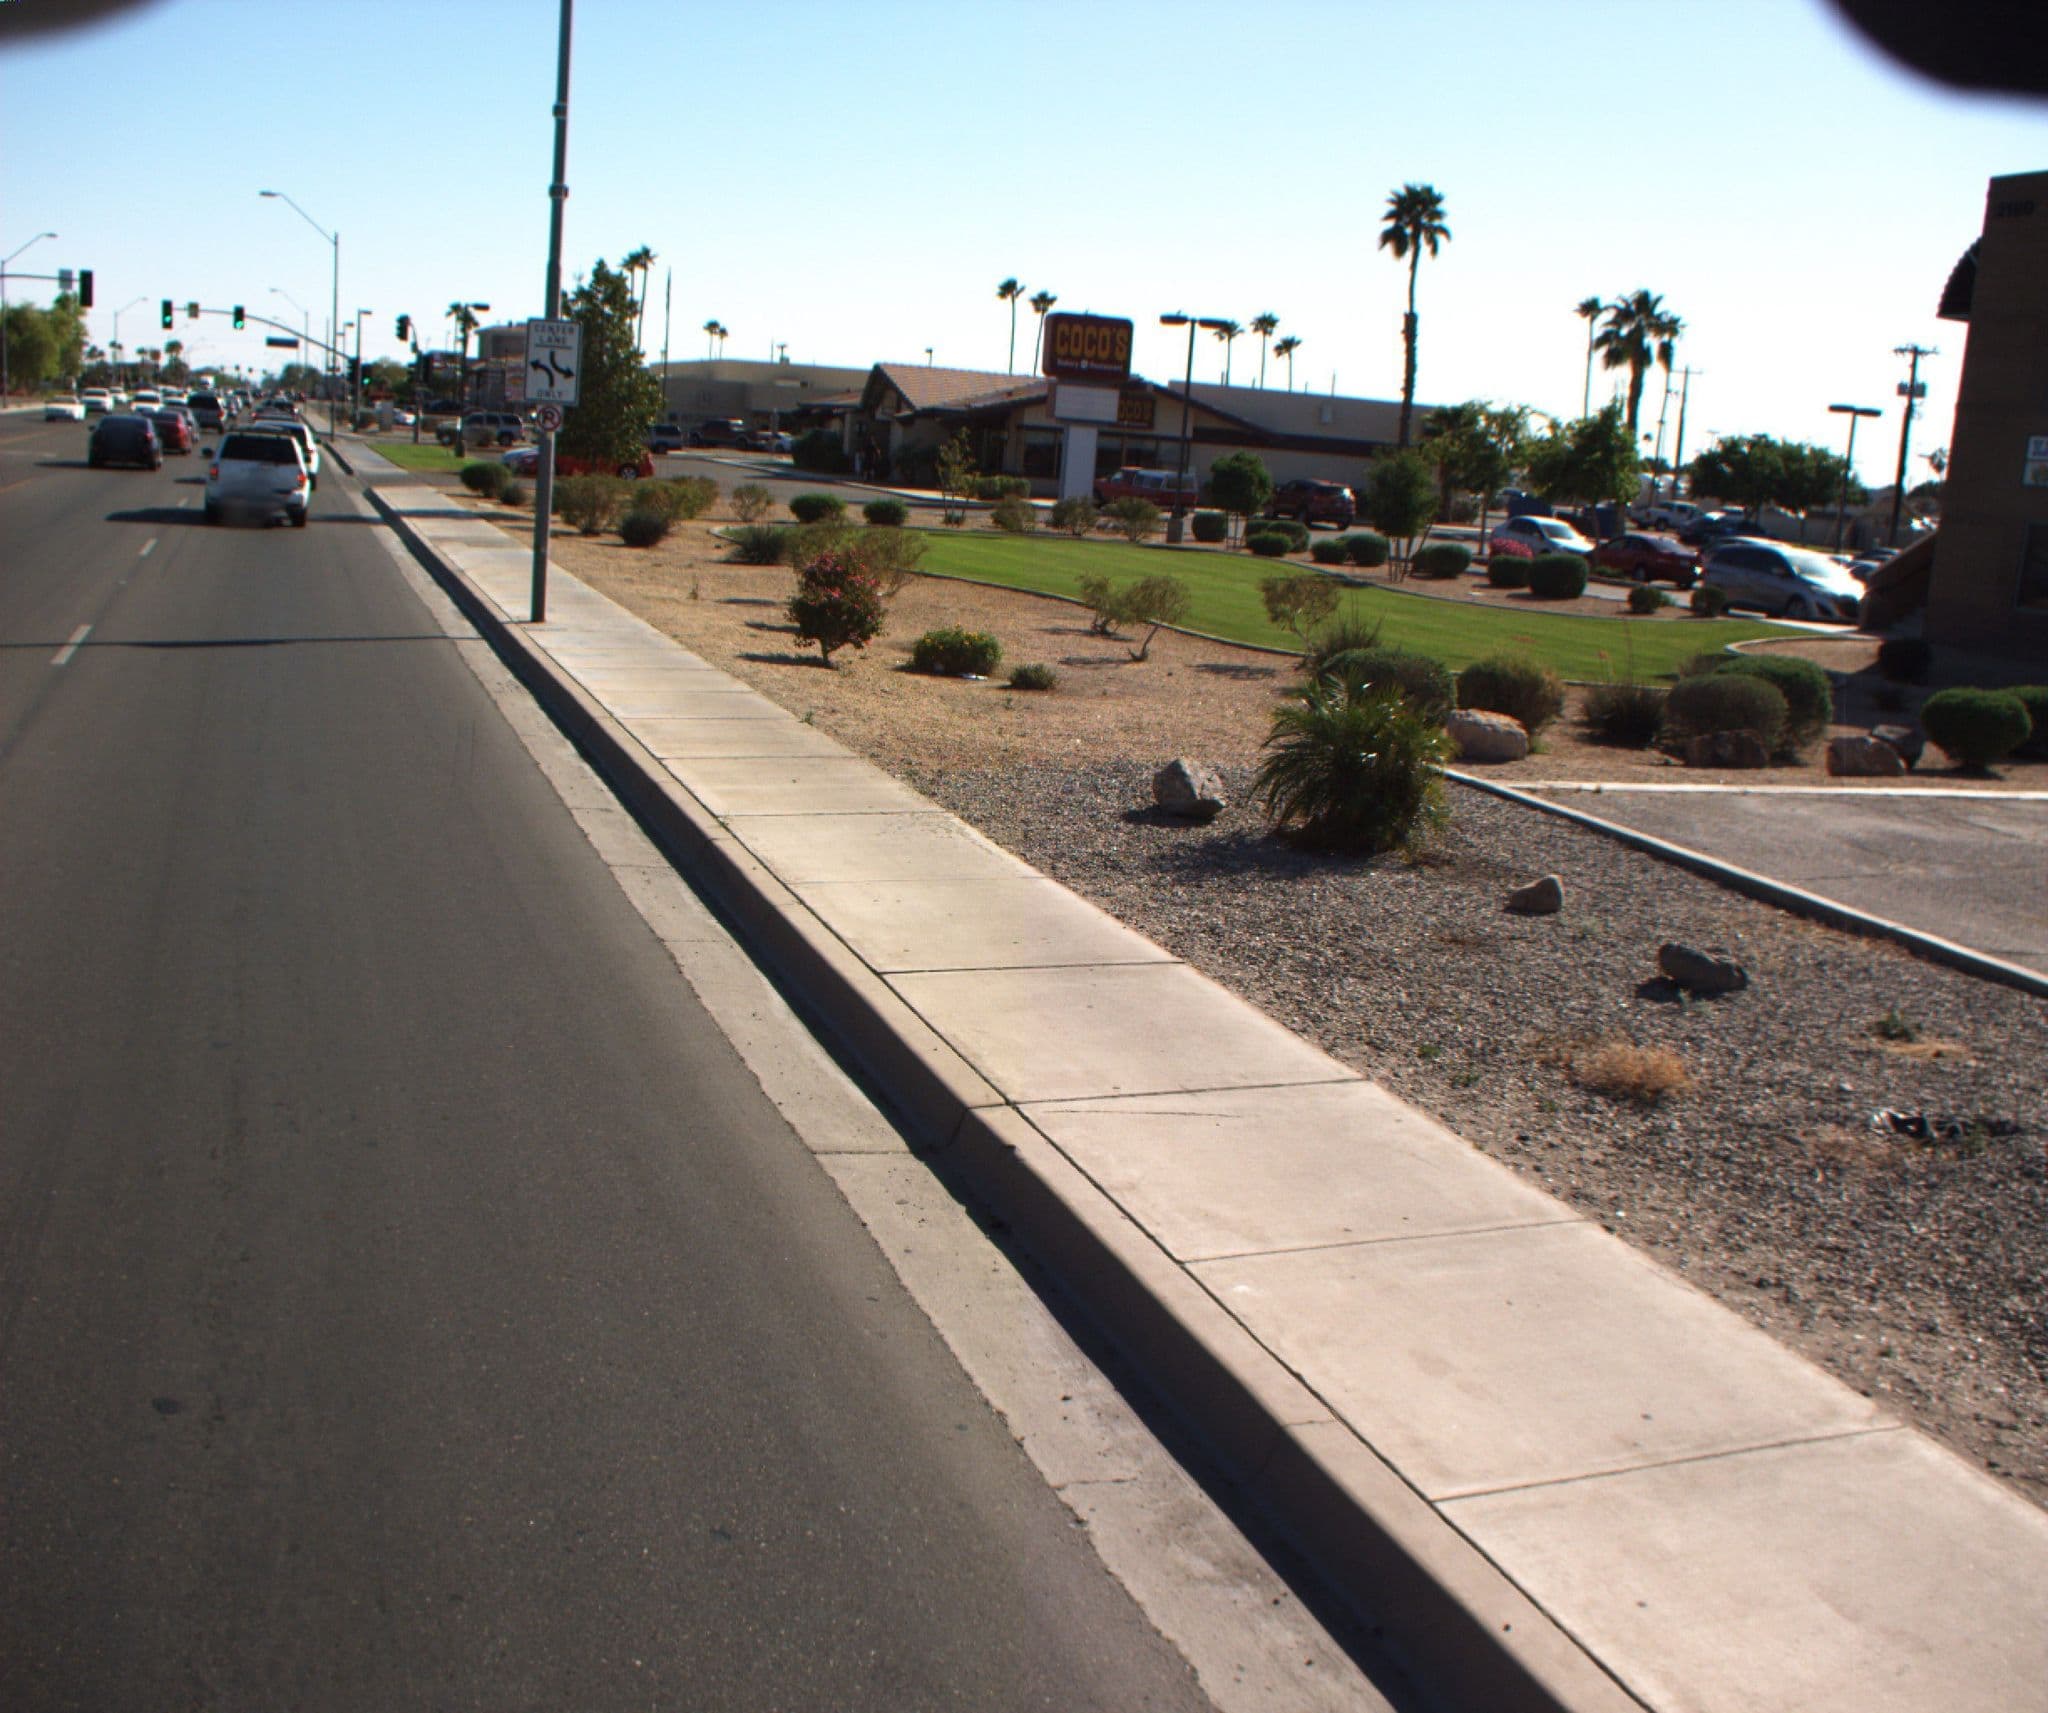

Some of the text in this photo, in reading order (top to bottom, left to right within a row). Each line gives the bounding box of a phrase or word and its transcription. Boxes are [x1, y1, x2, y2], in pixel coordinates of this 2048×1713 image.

[534, 323, 575, 335] CENTER
[538, 334, 567, 345] LANE
[1057, 323, 1128, 359] COCO'S
[537, 390, 563, 400] ONLY
